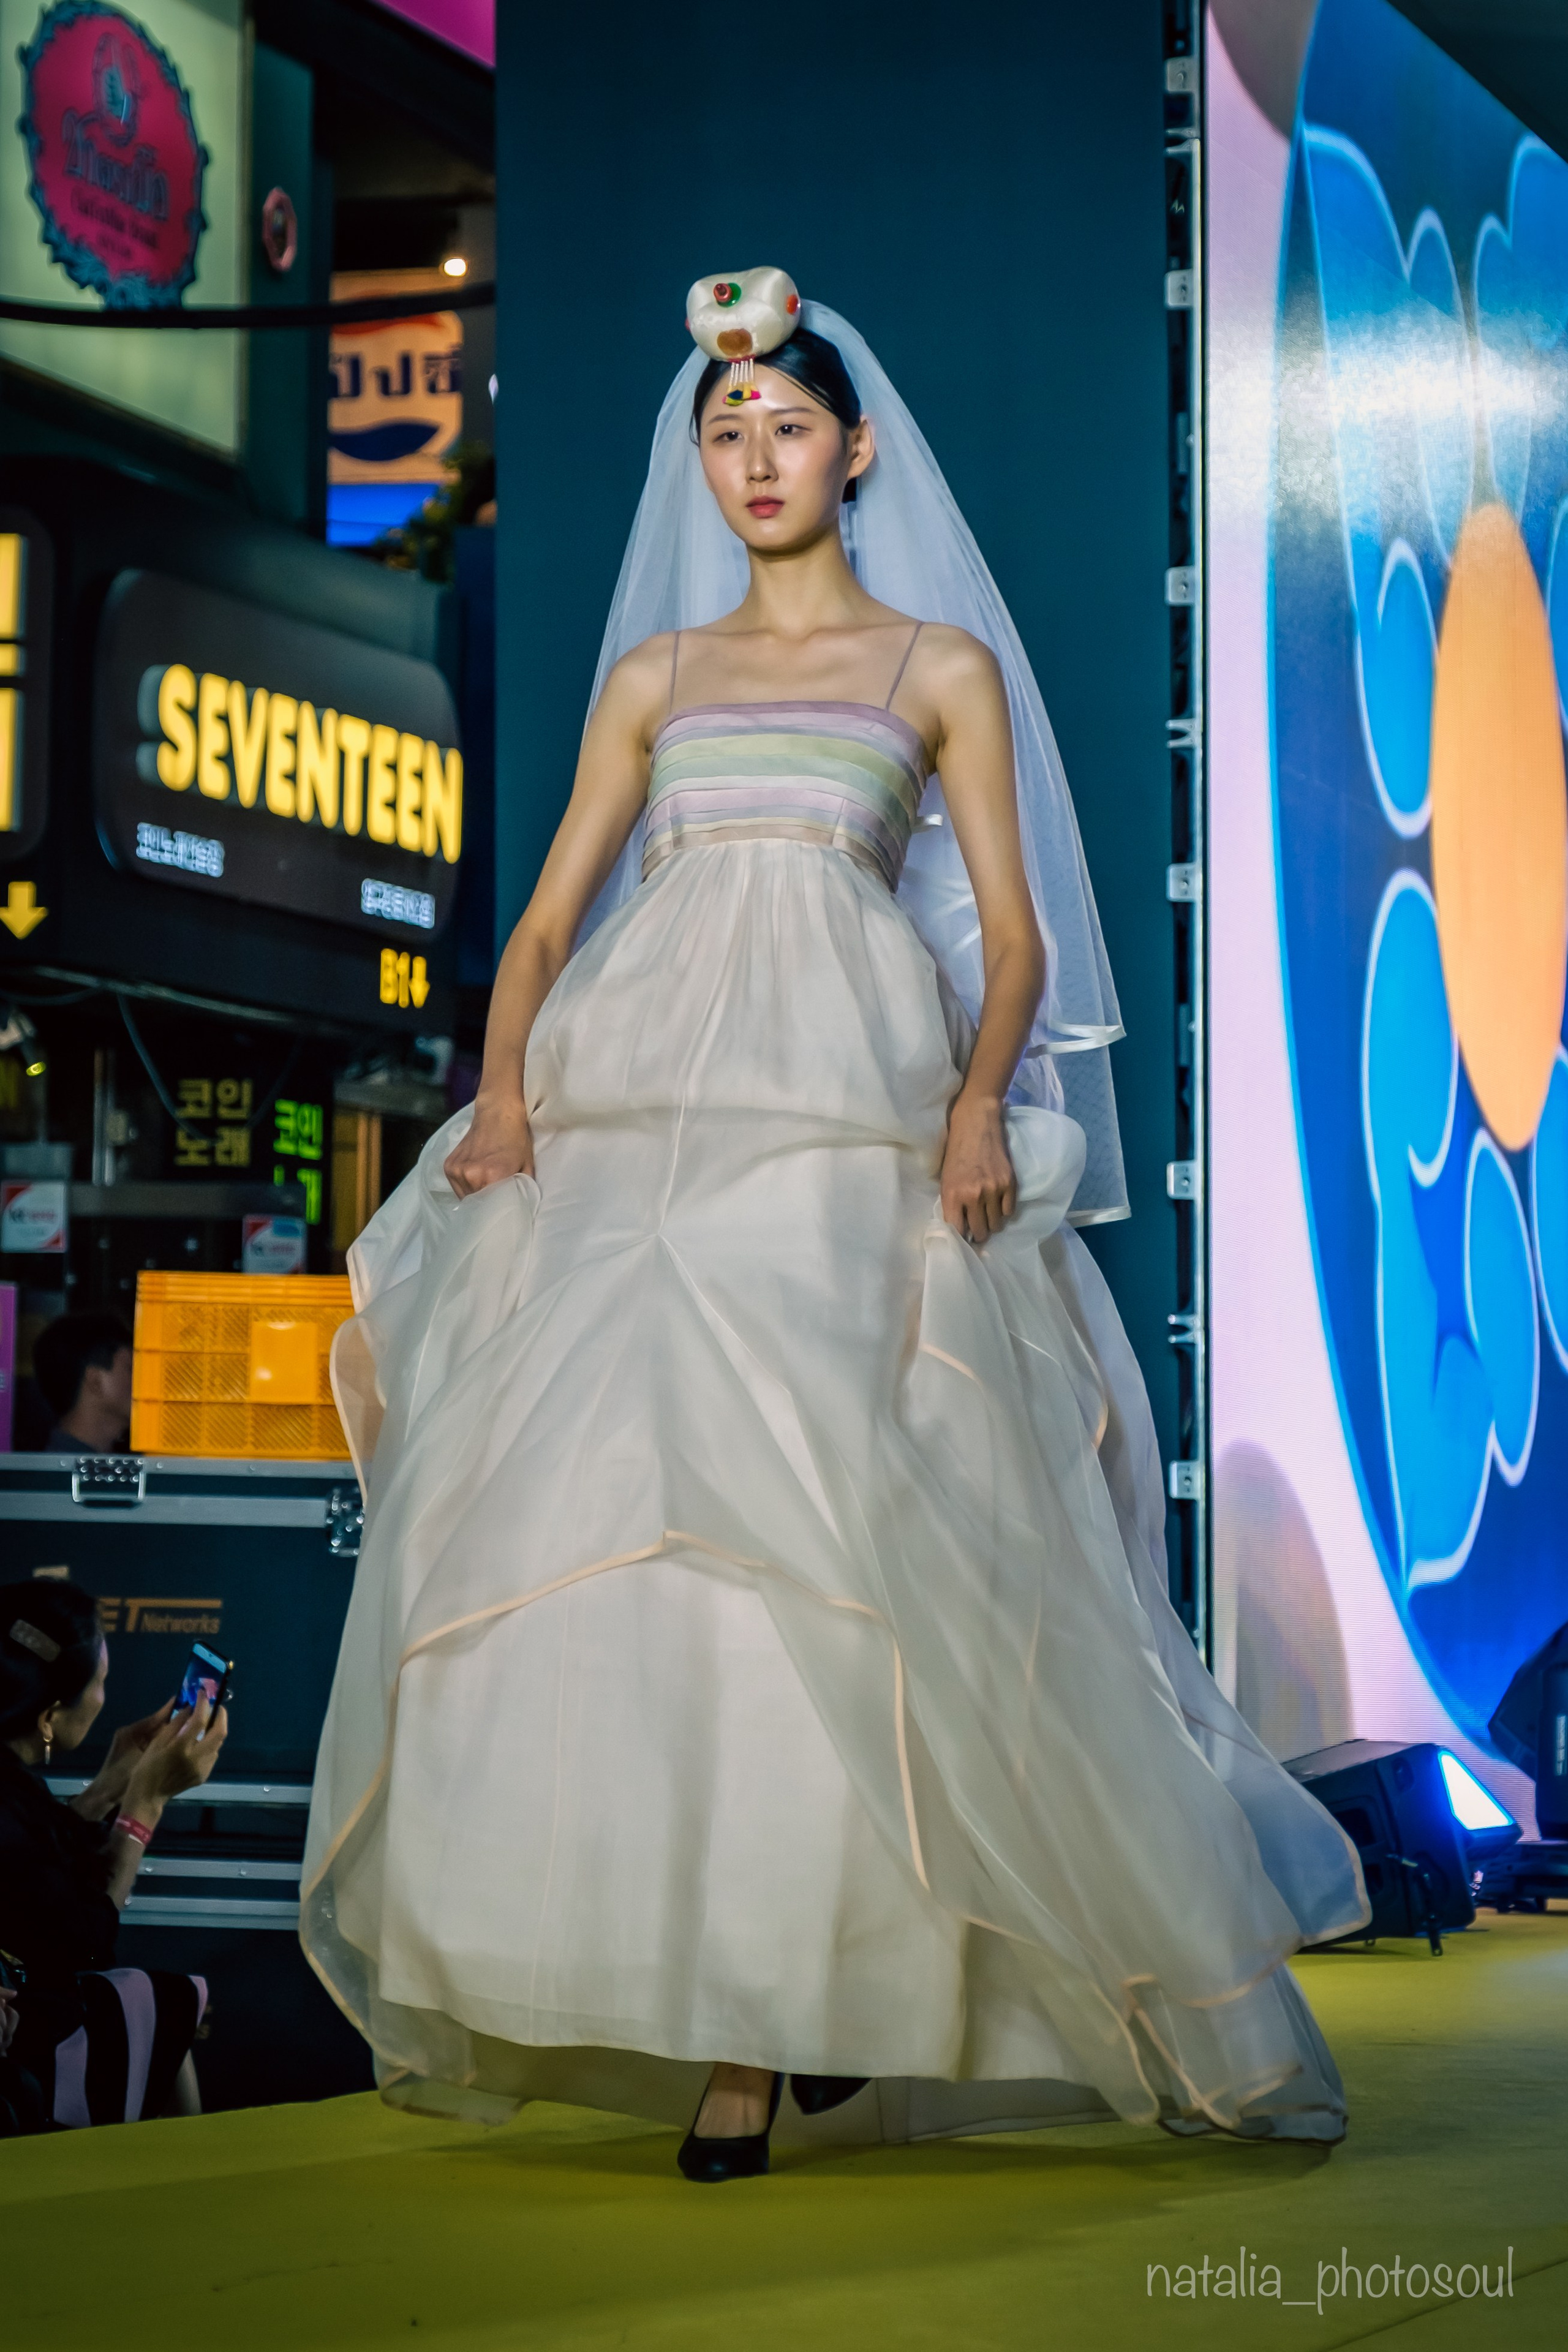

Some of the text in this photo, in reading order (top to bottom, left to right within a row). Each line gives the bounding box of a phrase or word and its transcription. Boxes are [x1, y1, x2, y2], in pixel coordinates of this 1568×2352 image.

[157, 664, 463, 864] SEVENTEEN
[380, 949, 410, 1008] B1
[177, 1079, 252, 1120] 코인
[175, 1126, 251, 1166] 노래
[273, 1099, 323, 1161] 코인
[141, 1615, 220, 1634] Networks
